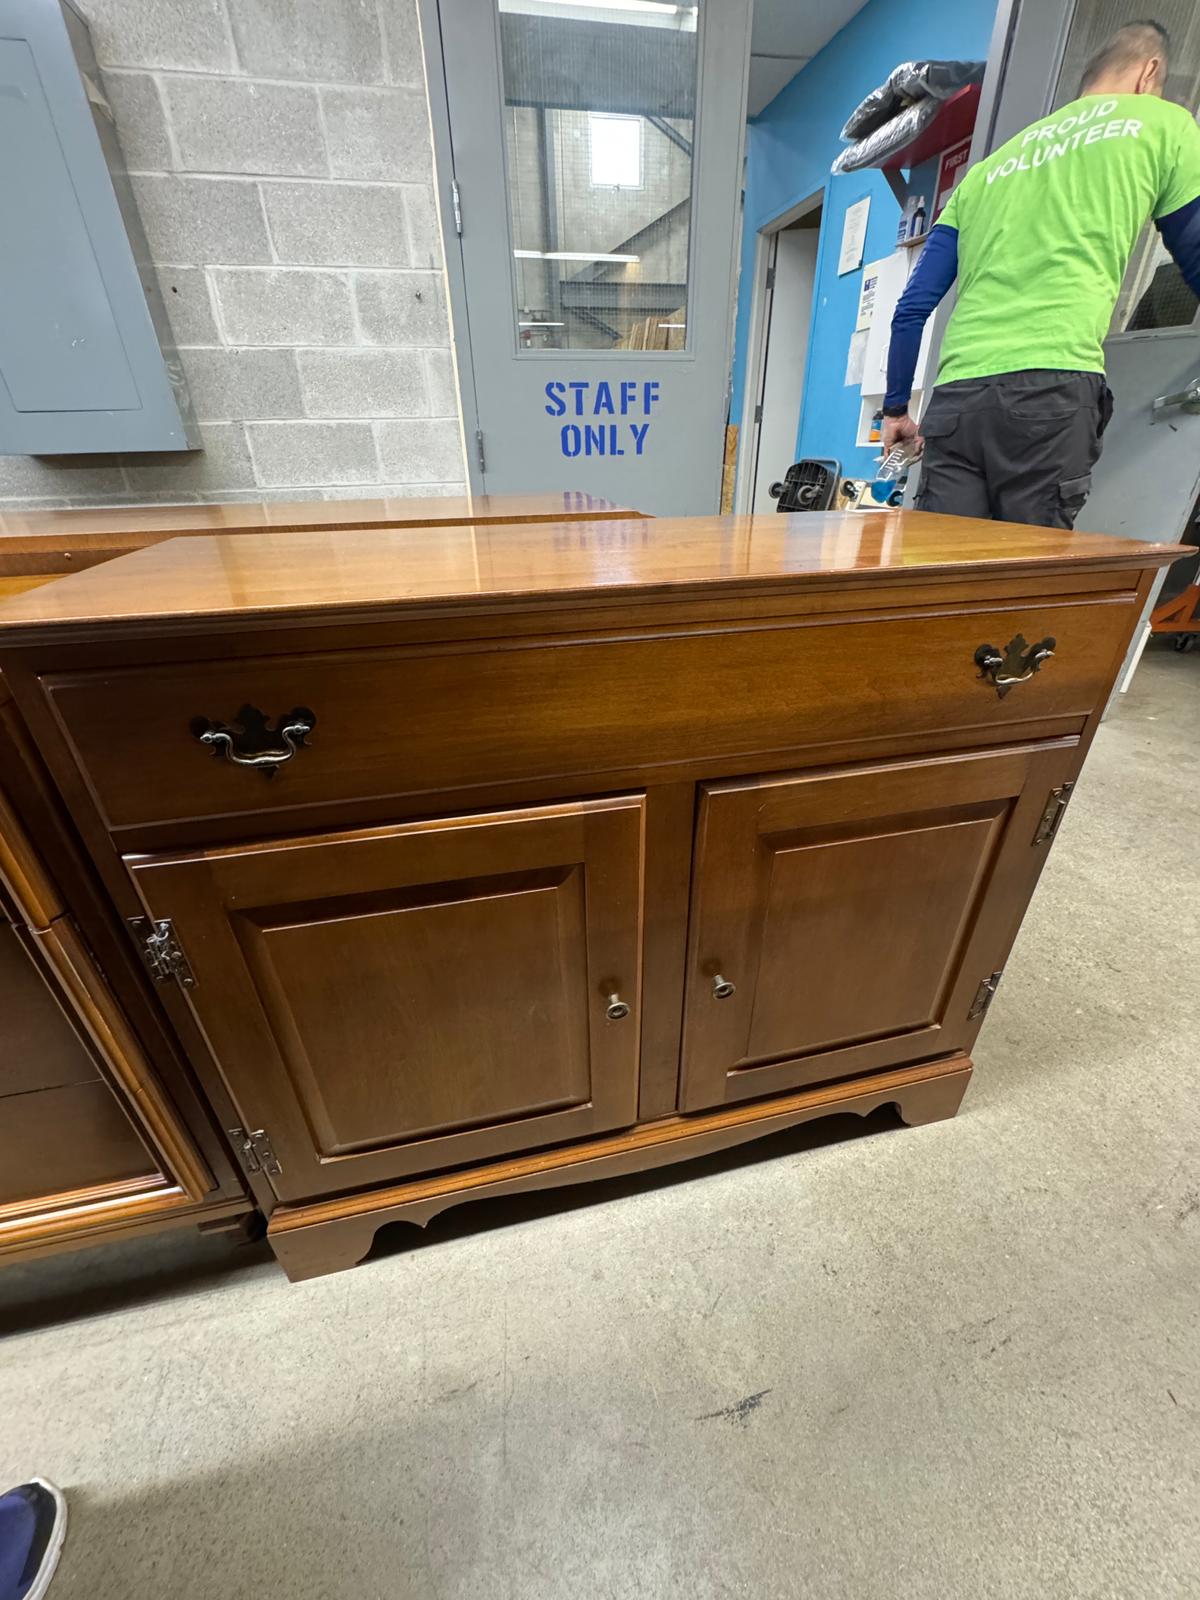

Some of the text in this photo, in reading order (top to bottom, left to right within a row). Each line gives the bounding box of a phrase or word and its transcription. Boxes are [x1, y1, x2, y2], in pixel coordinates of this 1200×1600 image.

[1021, 100, 1119, 148] PROUD
[986, 119, 1144, 185] VOLUNTEER
[545, 381, 660, 416] STAFF
[560, 423, 650, 457] ONLY
